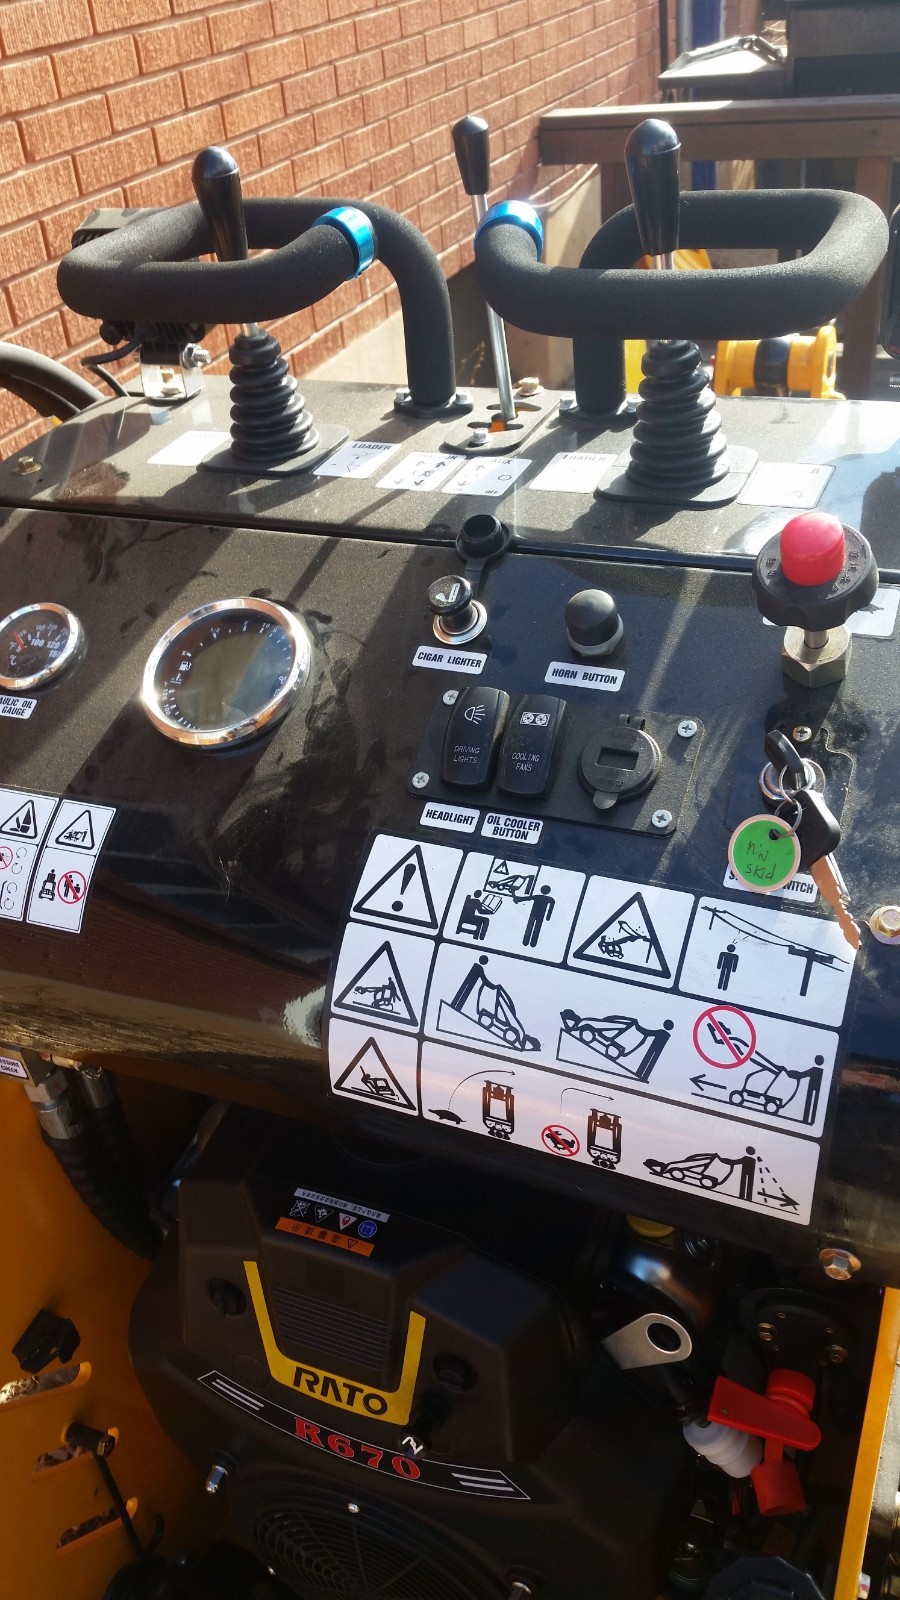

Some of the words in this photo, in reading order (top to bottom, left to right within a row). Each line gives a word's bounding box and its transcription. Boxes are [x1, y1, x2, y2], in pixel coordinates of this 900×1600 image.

[47, 641, 60, 649] 120
[417, 651, 444, 663] CIGAR
[447, 655, 482, 668] LIGHTER
[551, 668, 578, 680] HORN
[581, 672, 618, 685] BUTTON
[21, 700, 33, 709] OIL
[2, 706, 27, 716] GAUGE
[453, 745, 480, 755] DRIVING
[453, 755, 478, 764] LIGHTS
[511, 752, 540, 762] COOLING
[515, 762, 533, 772] FANS
[425, 809, 476, 826] HEADLIGHT
[487, 815, 501, 826] OIL
[503, 817, 541, 832] COOLER
[492, 826, 529, 841] BUTTON
[293, 1366, 388, 1416] RATO
[294, 1416, 420, 1480] R670
